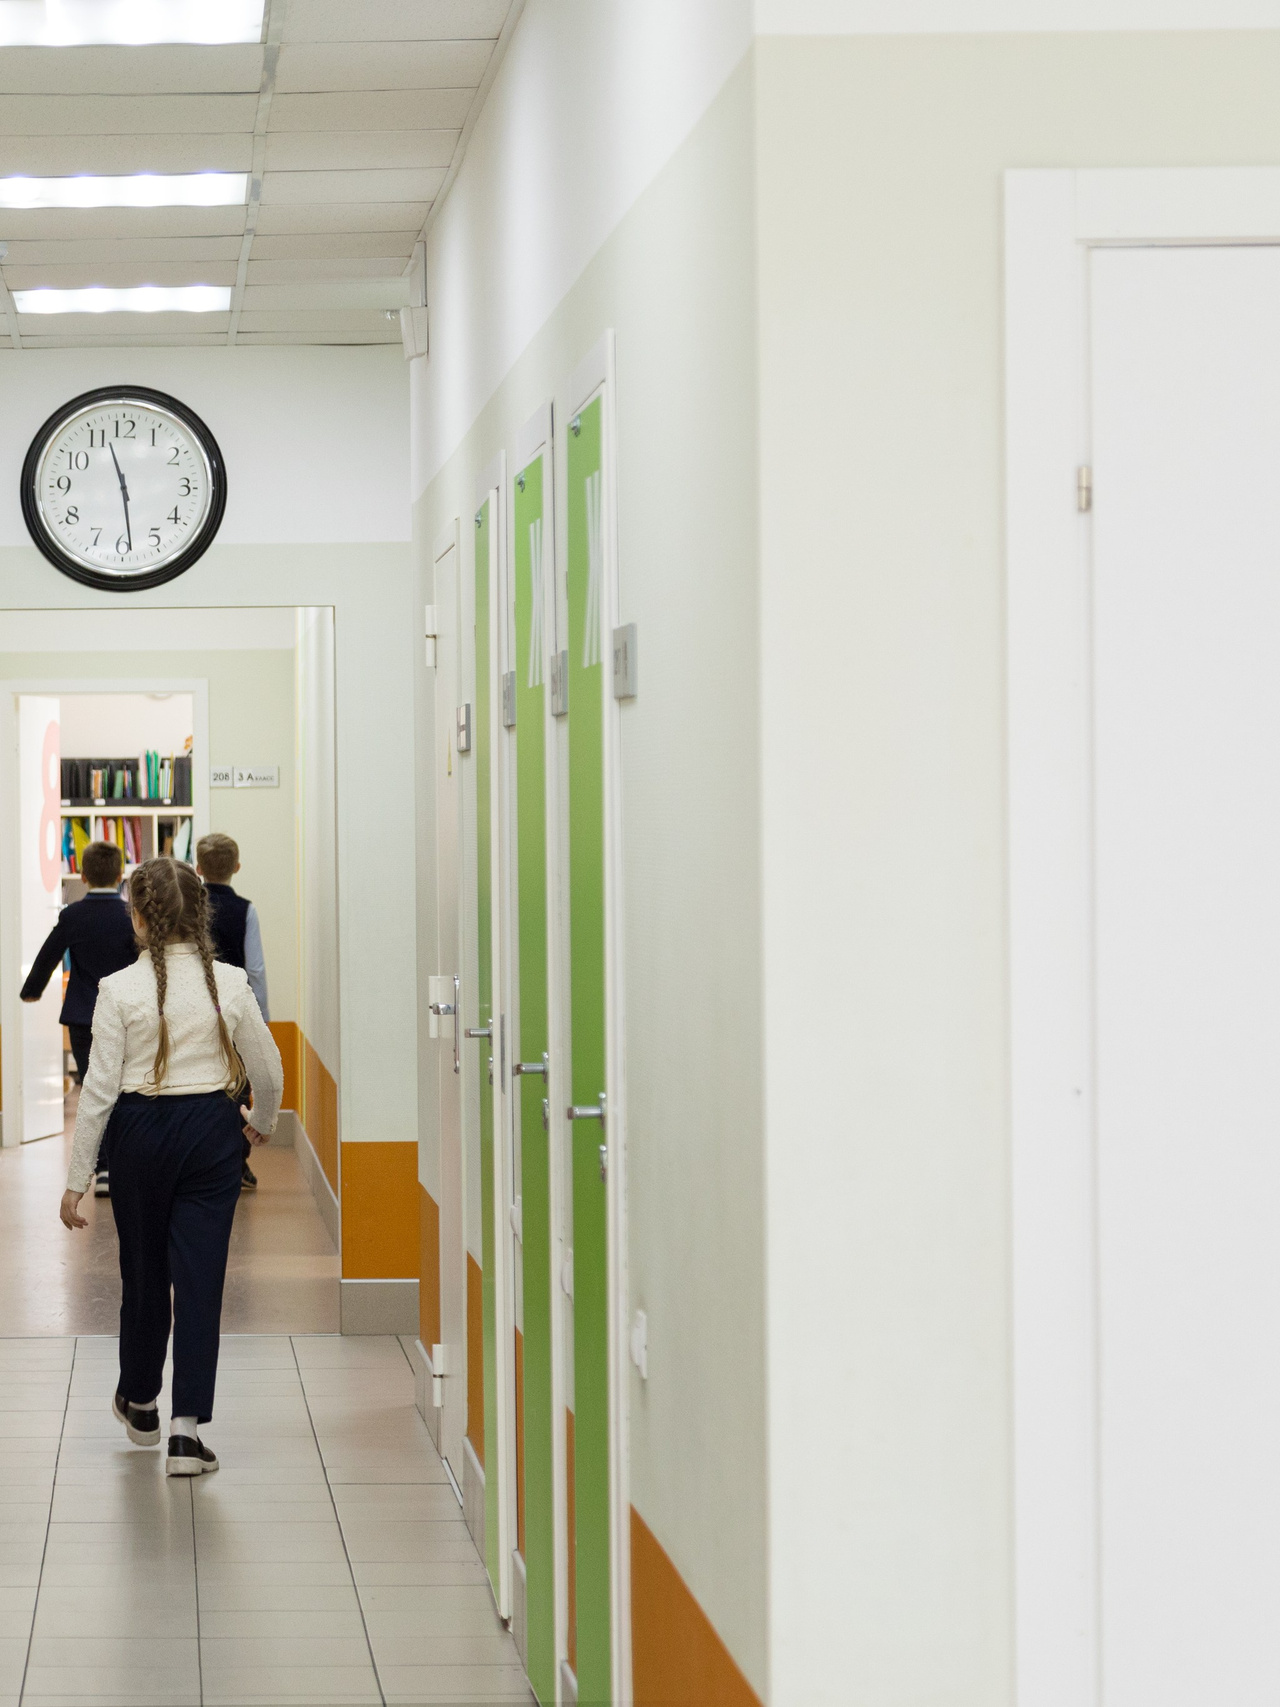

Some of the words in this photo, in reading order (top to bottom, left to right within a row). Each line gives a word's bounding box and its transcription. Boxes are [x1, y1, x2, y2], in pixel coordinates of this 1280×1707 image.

[89, 429, 105, 448] 11
[114, 420, 135, 438] 12
[150, 428, 157, 446] 1
[68, 451, 89, 470] 10
[167, 447, 180, 465] 2
[57, 476, 71, 496] 9
[178, 477, 191, 496] 3
[65, 506, 79, 525] 8
[167, 505, 181, 524] 4
[91, 528, 103, 546] 7
[115, 534, 130, 555] 6
[148, 528, 161, 546] 5
[238, 772, 244, 781] 3
